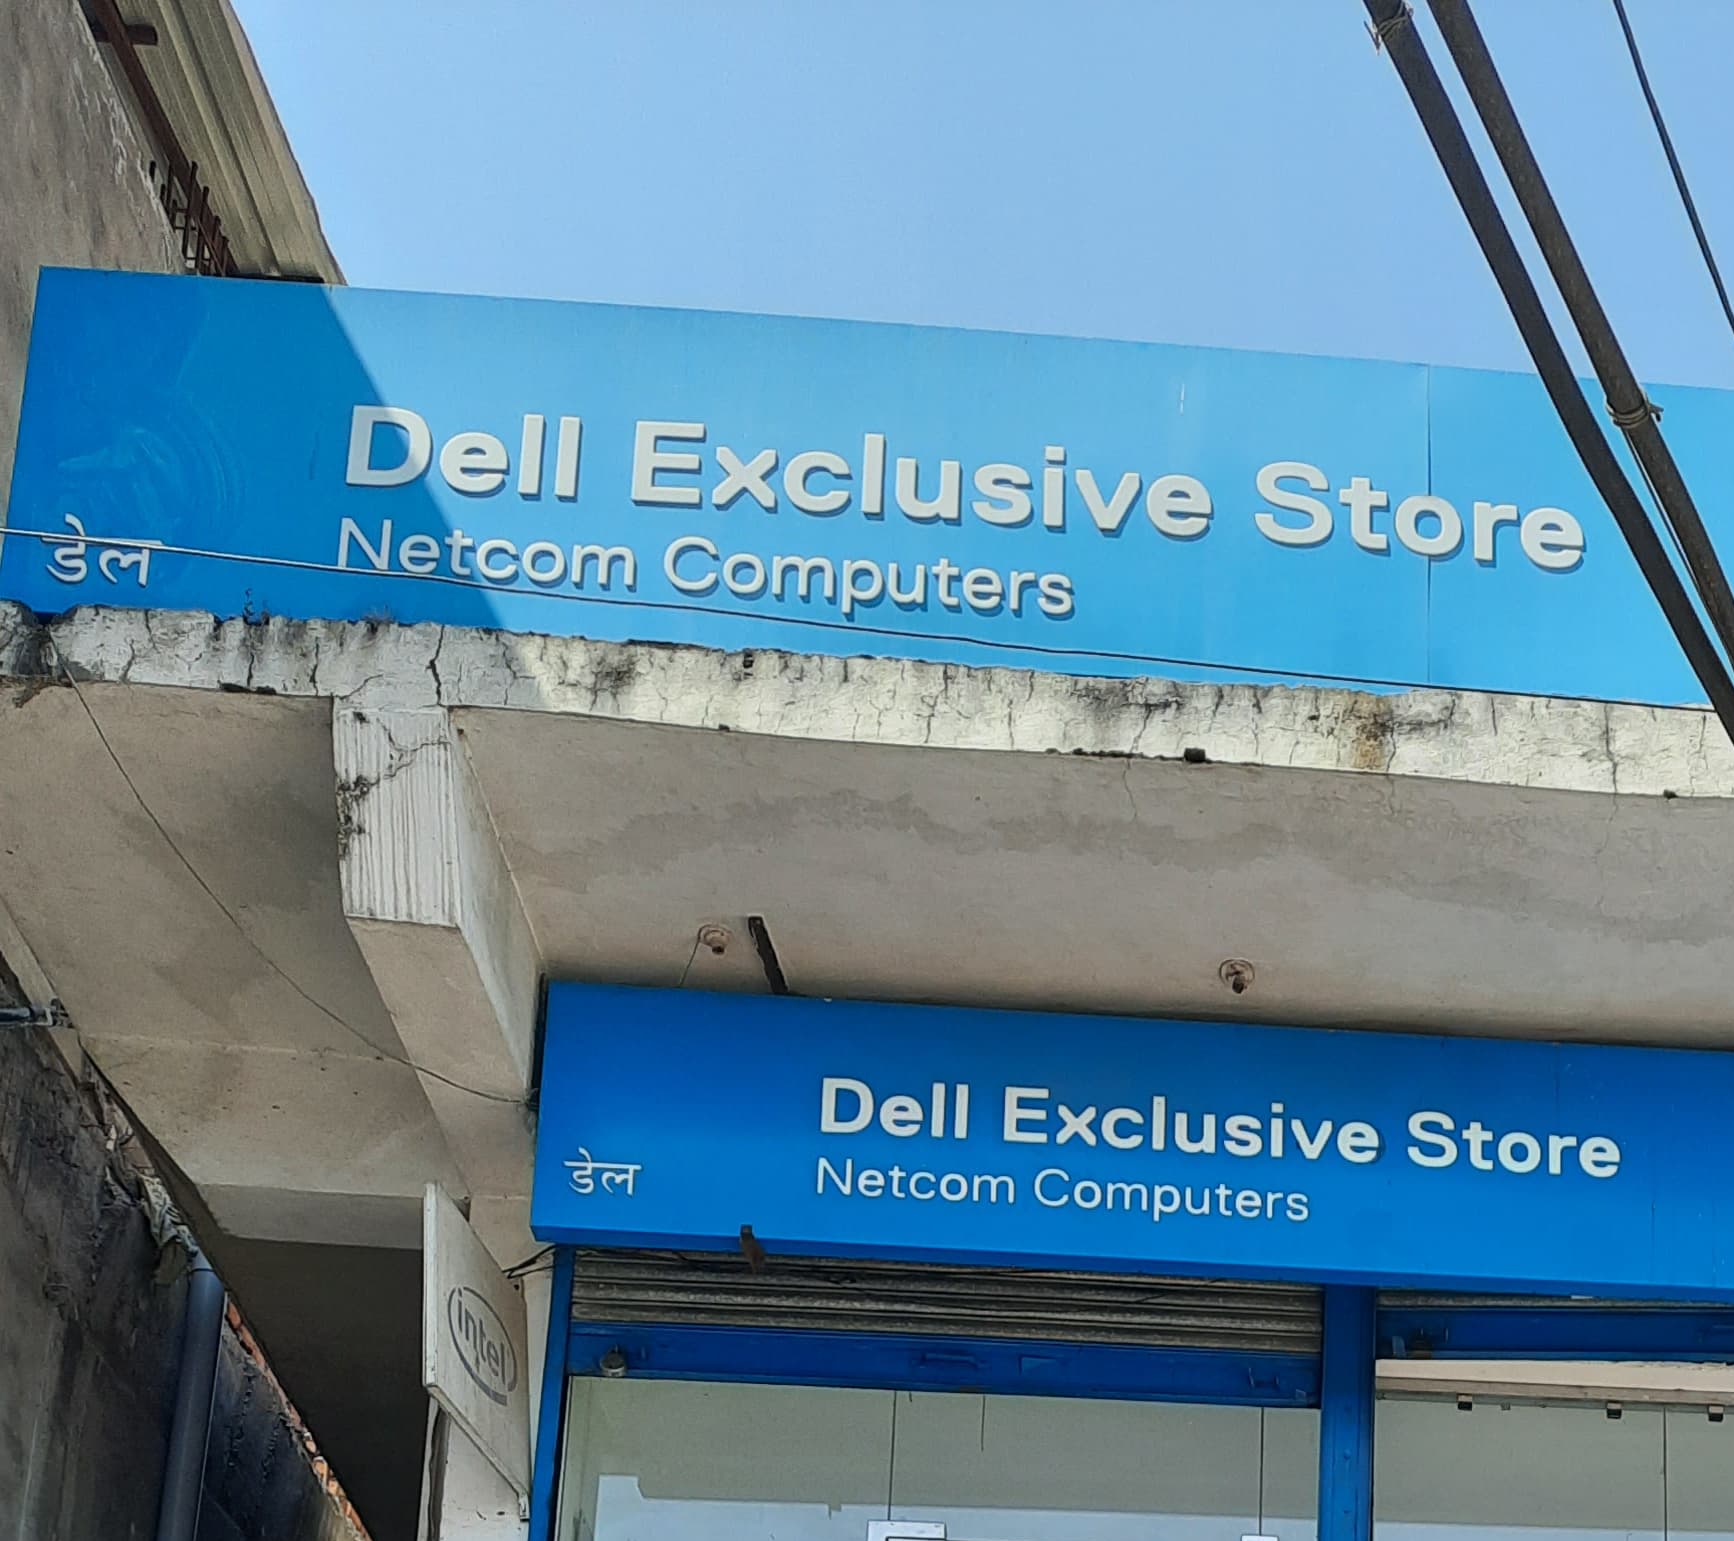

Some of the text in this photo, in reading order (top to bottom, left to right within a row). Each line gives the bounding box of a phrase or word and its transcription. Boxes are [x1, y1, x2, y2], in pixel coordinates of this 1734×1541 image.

[345, 404, 1588, 573] Dell Exclusive Store
[45, 514, 163, 588] डेल
[335, 516, 1076, 618] Netcom Computers
[563, 1146, 642, 1197] डेल
[820, 1077, 1622, 1178] Dell Exclusive Store
[816, 1157, 1311, 1224] Netcom Computers
[456, 1287, 508, 1387] intel
